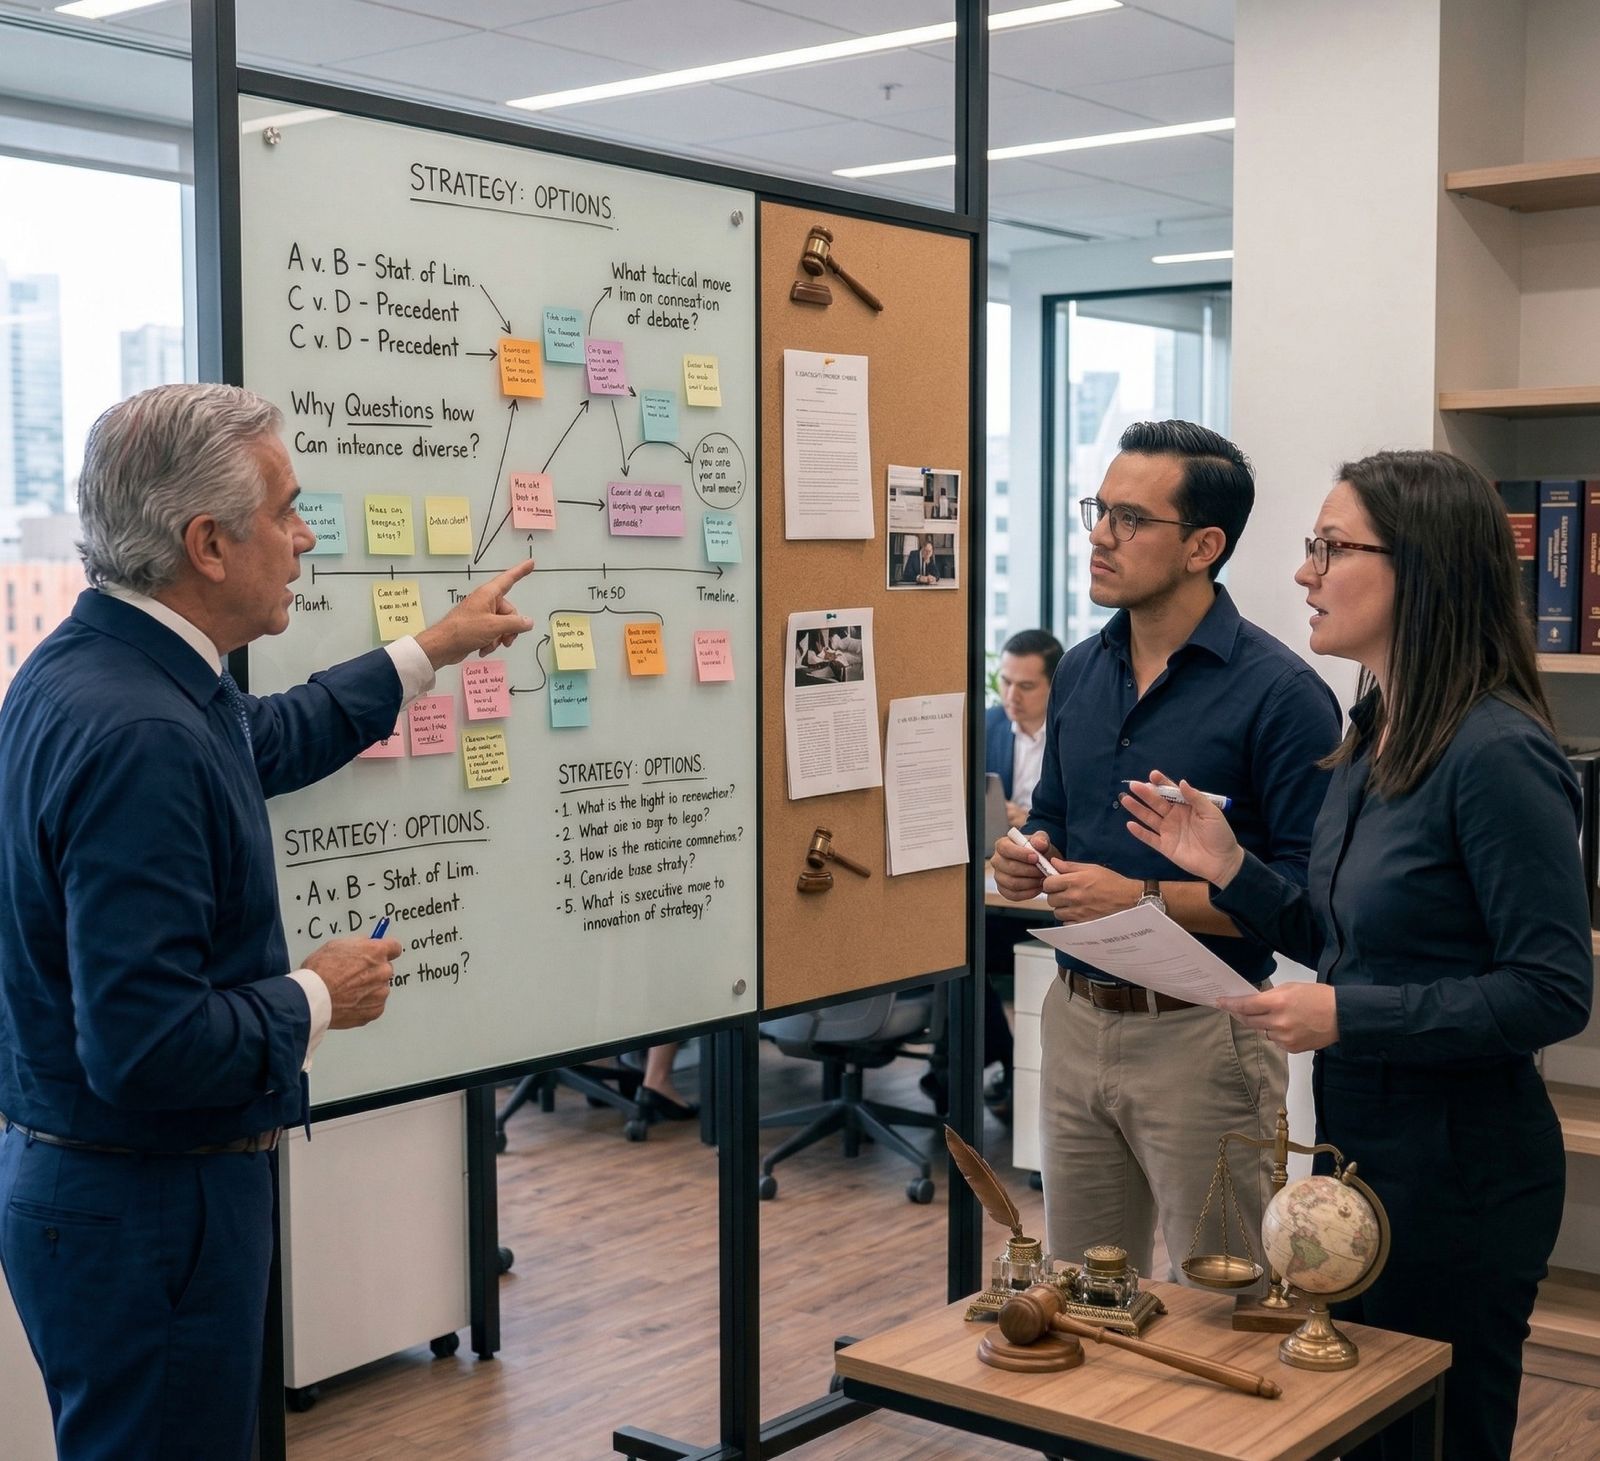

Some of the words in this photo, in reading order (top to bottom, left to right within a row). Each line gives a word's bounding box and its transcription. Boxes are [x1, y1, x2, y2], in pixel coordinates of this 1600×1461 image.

[410, 163, 524, 204] STRATEGY:
[288, 242, 304, 271] A
[312, 257, 326, 273] v.
[334, 248, 349, 275] B
[375, 254, 415, 281] Stat.
[420, 260, 436, 284] of
[443, 263, 475, 288] Lim.
[611, 261, 647, 282] What
[652, 265, 698, 288] tactical
[702, 277, 732, 293] move
[288, 285, 304, 311] C
[313, 296, 327, 311] v.
[335, 289, 351, 313] D
[377, 291, 460, 322] Precedent
[627, 308, 641, 325] of
[647, 309, 699, 331] debate?
[290, 323, 306, 349] C
[314, 335, 328, 349] v.
[336, 326, 352, 350] D
[378, 328, 460, 357] Precedent
[291, 390, 335, 428] Why
[345, 392, 434, 420] Questions
[442, 398, 475, 422] how
[294, 431, 328, 454] Can
[412, 432, 480, 459] diverse?
[559, 760, 639, 785] STRATEGY:
[644, 753, 706, 777] OPTIONS.
[577, 798, 605, 815] What
[608, 798, 617, 811] is
[620, 794, 637, 809] the
[579, 820, 609, 838] What
[668, 812, 678, 826] to
[682, 806, 710, 828] lego?
[285, 819, 397, 856] STRATEGY:
[405, 809, 490, 839] OPTIONS.
[580, 846, 604, 862] How
[608, 844, 618, 858] is
[621, 840, 640, 855] the
[307, 880, 321, 906] A
[327, 888, 340, 901] v.
[346, 875, 361, 899] B
[383, 867, 421, 891] Stat.
[426, 862, 440, 884] of
[447, 861, 479, 880] Lim.
[582, 890, 615, 911] What
[620, 890, 630, 905] is
[714, 875, 725, 889] to
[308, 916, 323, 940] C
[329, 922, 342, 935] v.
[348, 910, 363, 931] D
[385, 892, 465, 922] Precedent.
[583, 910, 641, 932] innovation
[644, 904, 656, 920] of
[660, 894, 712, 920] strategy?
[417, 951, 470, 985] thoug?
